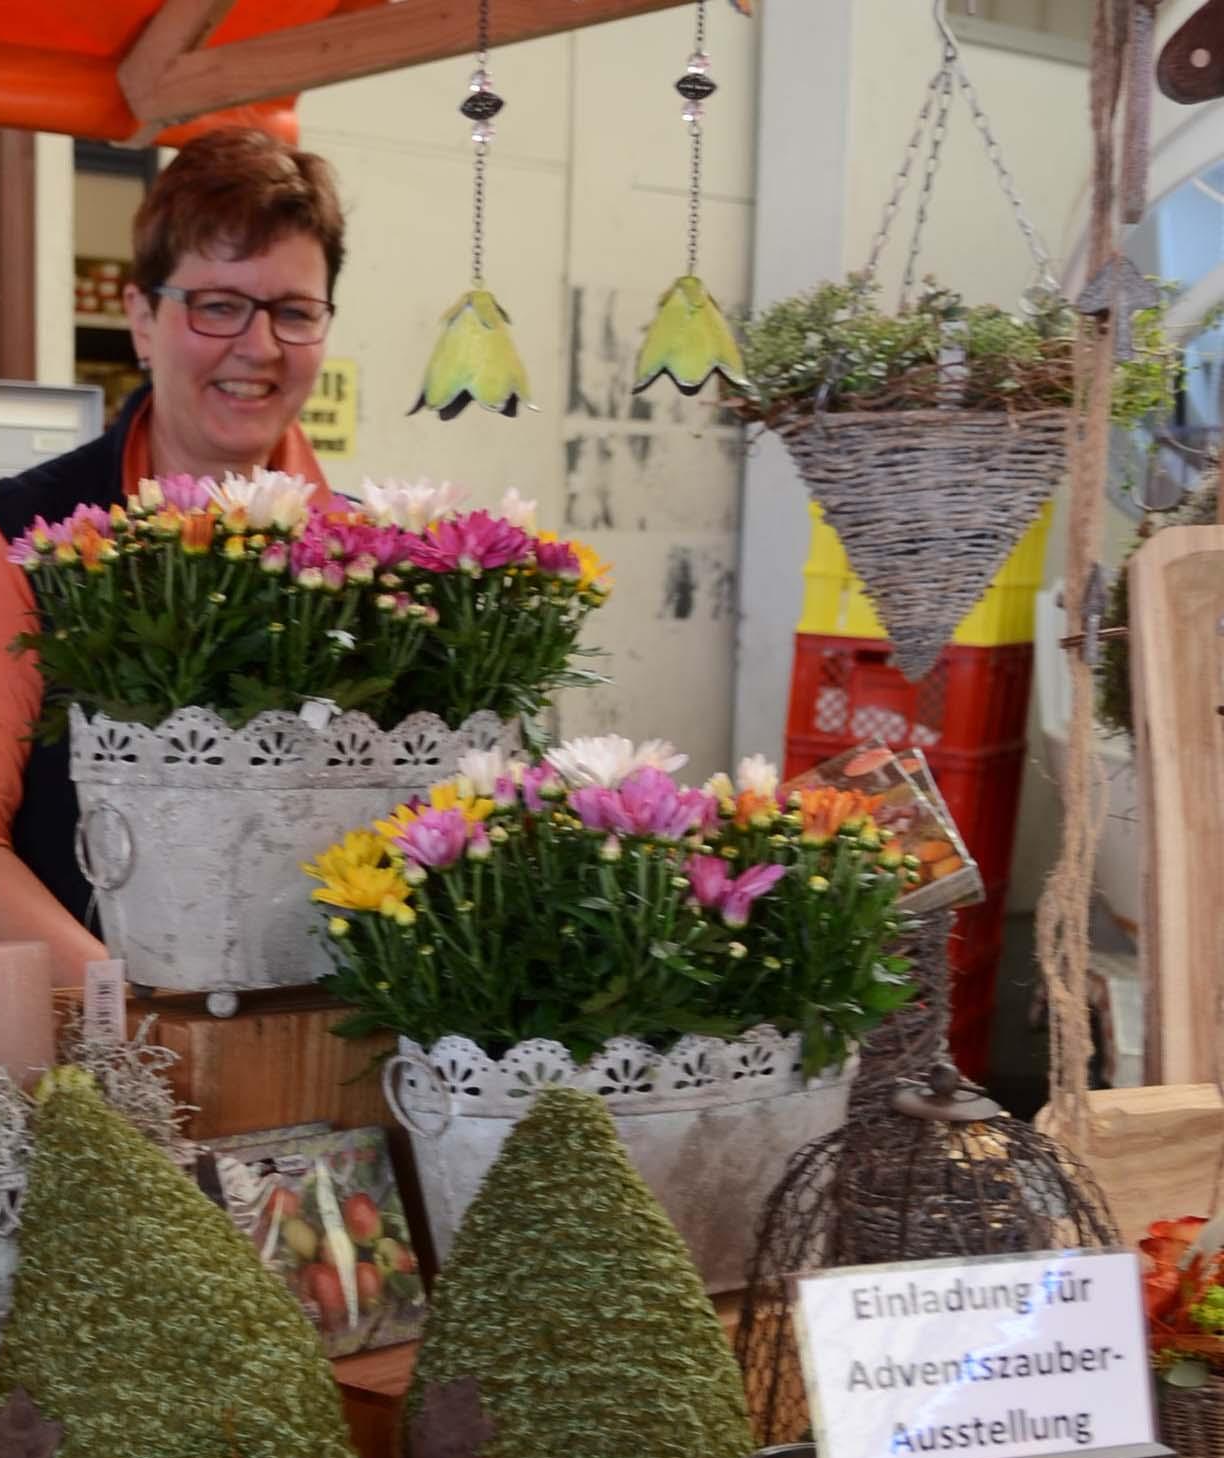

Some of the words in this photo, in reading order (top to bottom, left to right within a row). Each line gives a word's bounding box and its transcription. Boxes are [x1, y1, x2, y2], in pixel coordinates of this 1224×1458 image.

[851, 1277, 1033, 1320] Einladung
[1044, 1268, 1093, 1306] für
[846, 1341, 1126, 1393] Adventszauber-
[889, 1408, 1093, 1457] Ausstellung
